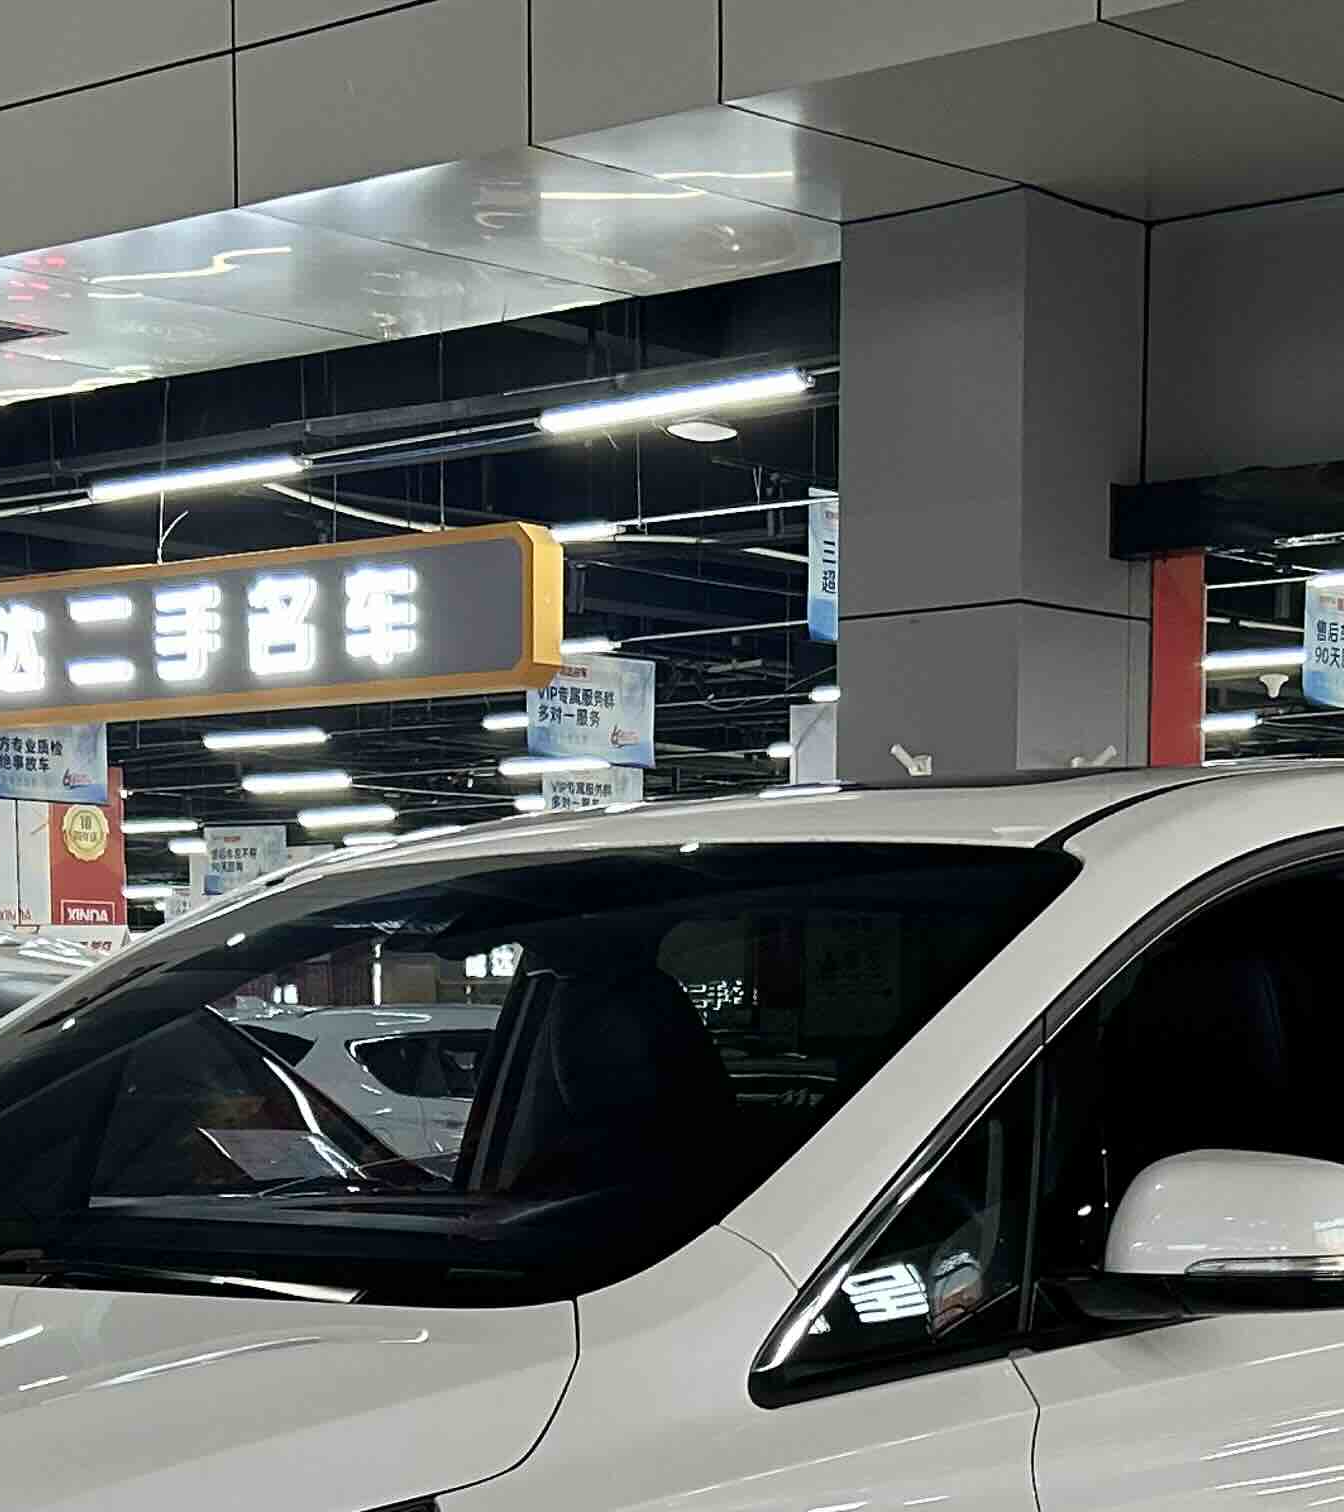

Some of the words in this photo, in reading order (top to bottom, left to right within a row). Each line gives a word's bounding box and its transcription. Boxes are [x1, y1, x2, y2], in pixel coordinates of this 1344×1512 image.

[538, 703, 601, 728] 多对一服务
[66, 907, 109, 922] XINDA
